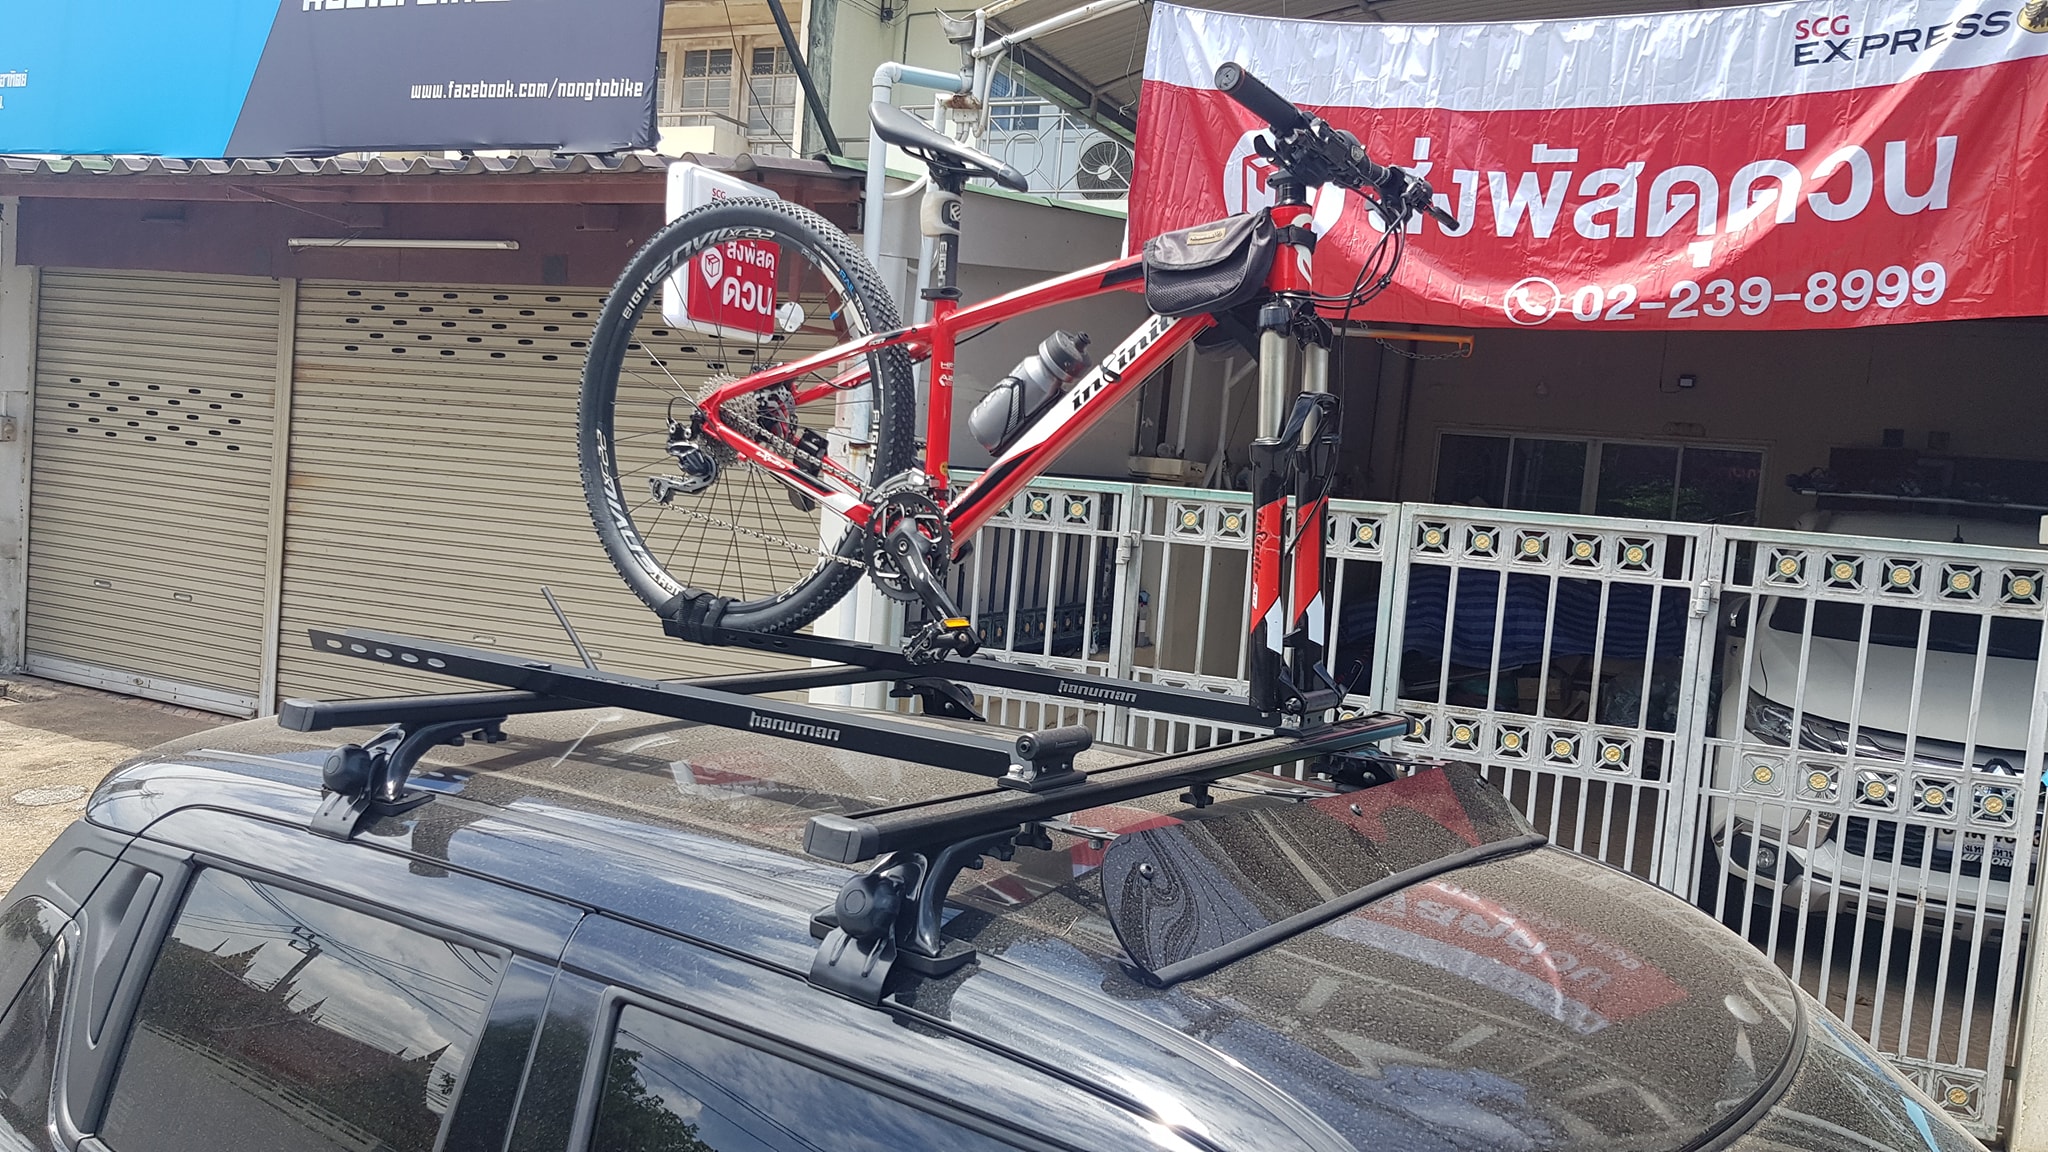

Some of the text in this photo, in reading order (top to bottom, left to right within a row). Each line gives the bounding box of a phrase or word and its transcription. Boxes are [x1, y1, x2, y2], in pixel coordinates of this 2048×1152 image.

[1793, 10, 2014, 67] EXPRESS
[1795, 15, 1850, 40] SCG
[410, 78, 645, 101] www.facebook.com/nongtobike
[726, 241, 776, 279] สงพัสดุ
[622, 272, 653, 321] EIGHT
[722, 265, 774, 317] ด่วน
[1571, 262, 1948, 322] 02-239-8999
[1058, 680, 1137, 702] hanuman
[749, 710, 841, 741] hanuman
